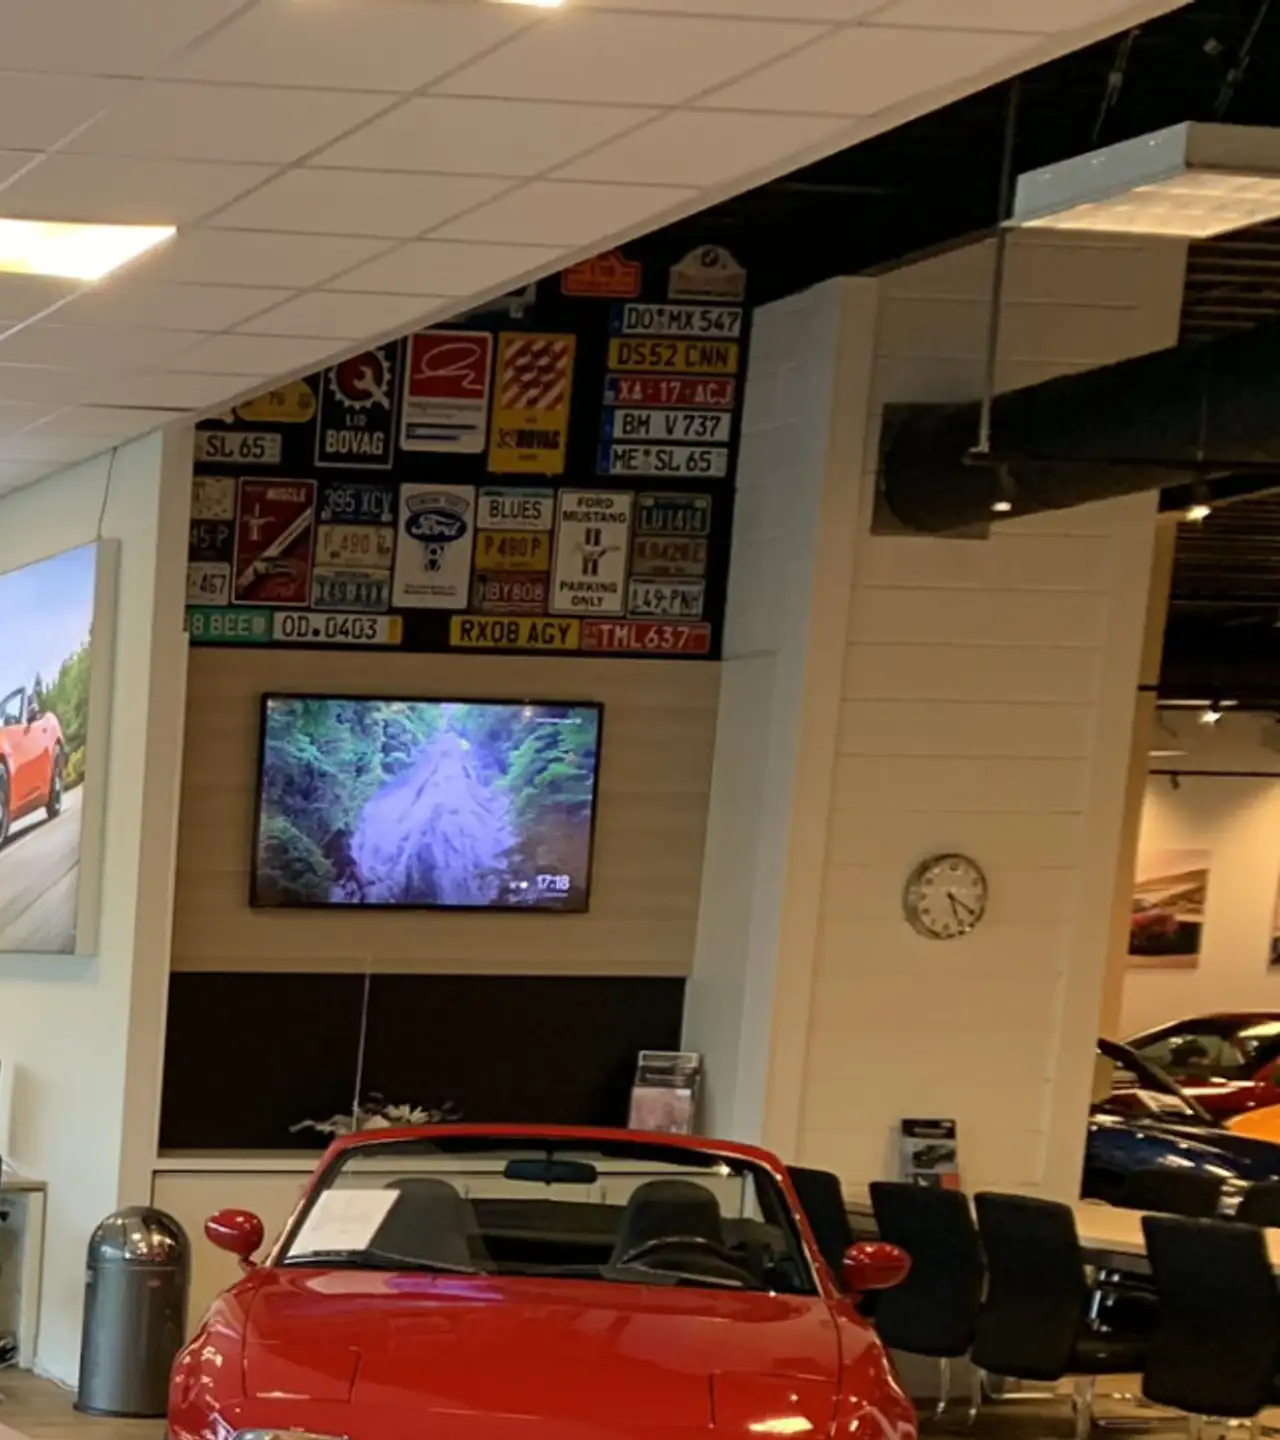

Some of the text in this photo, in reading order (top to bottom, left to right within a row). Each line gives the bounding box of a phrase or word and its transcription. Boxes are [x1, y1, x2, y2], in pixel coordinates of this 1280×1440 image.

[625, 306, 740, 333] DO MX 547
[617, 342, 729, 368] DS52 CNN
[622, 413, 722, 438] BM V 737
[205, 434, 267, 460] SL 65
[324, 430, 385, 456] BOVAG
[612, 449, 713, 473] ME SL 65
[489, 499, 543, 520] BLUES
[577, 496, 614, 508] FORD
[409, 512, 464, 538] Ford
[561, 510, 628, 524] MUSTANG
[560, 581, 618, 594] PARKING
[571, 595, 605, 608] ONLY
[459, 620, 521, 643] RX08
[527, 621, 572, 646] AGY
[535, 873, 571, 891] 17:18
